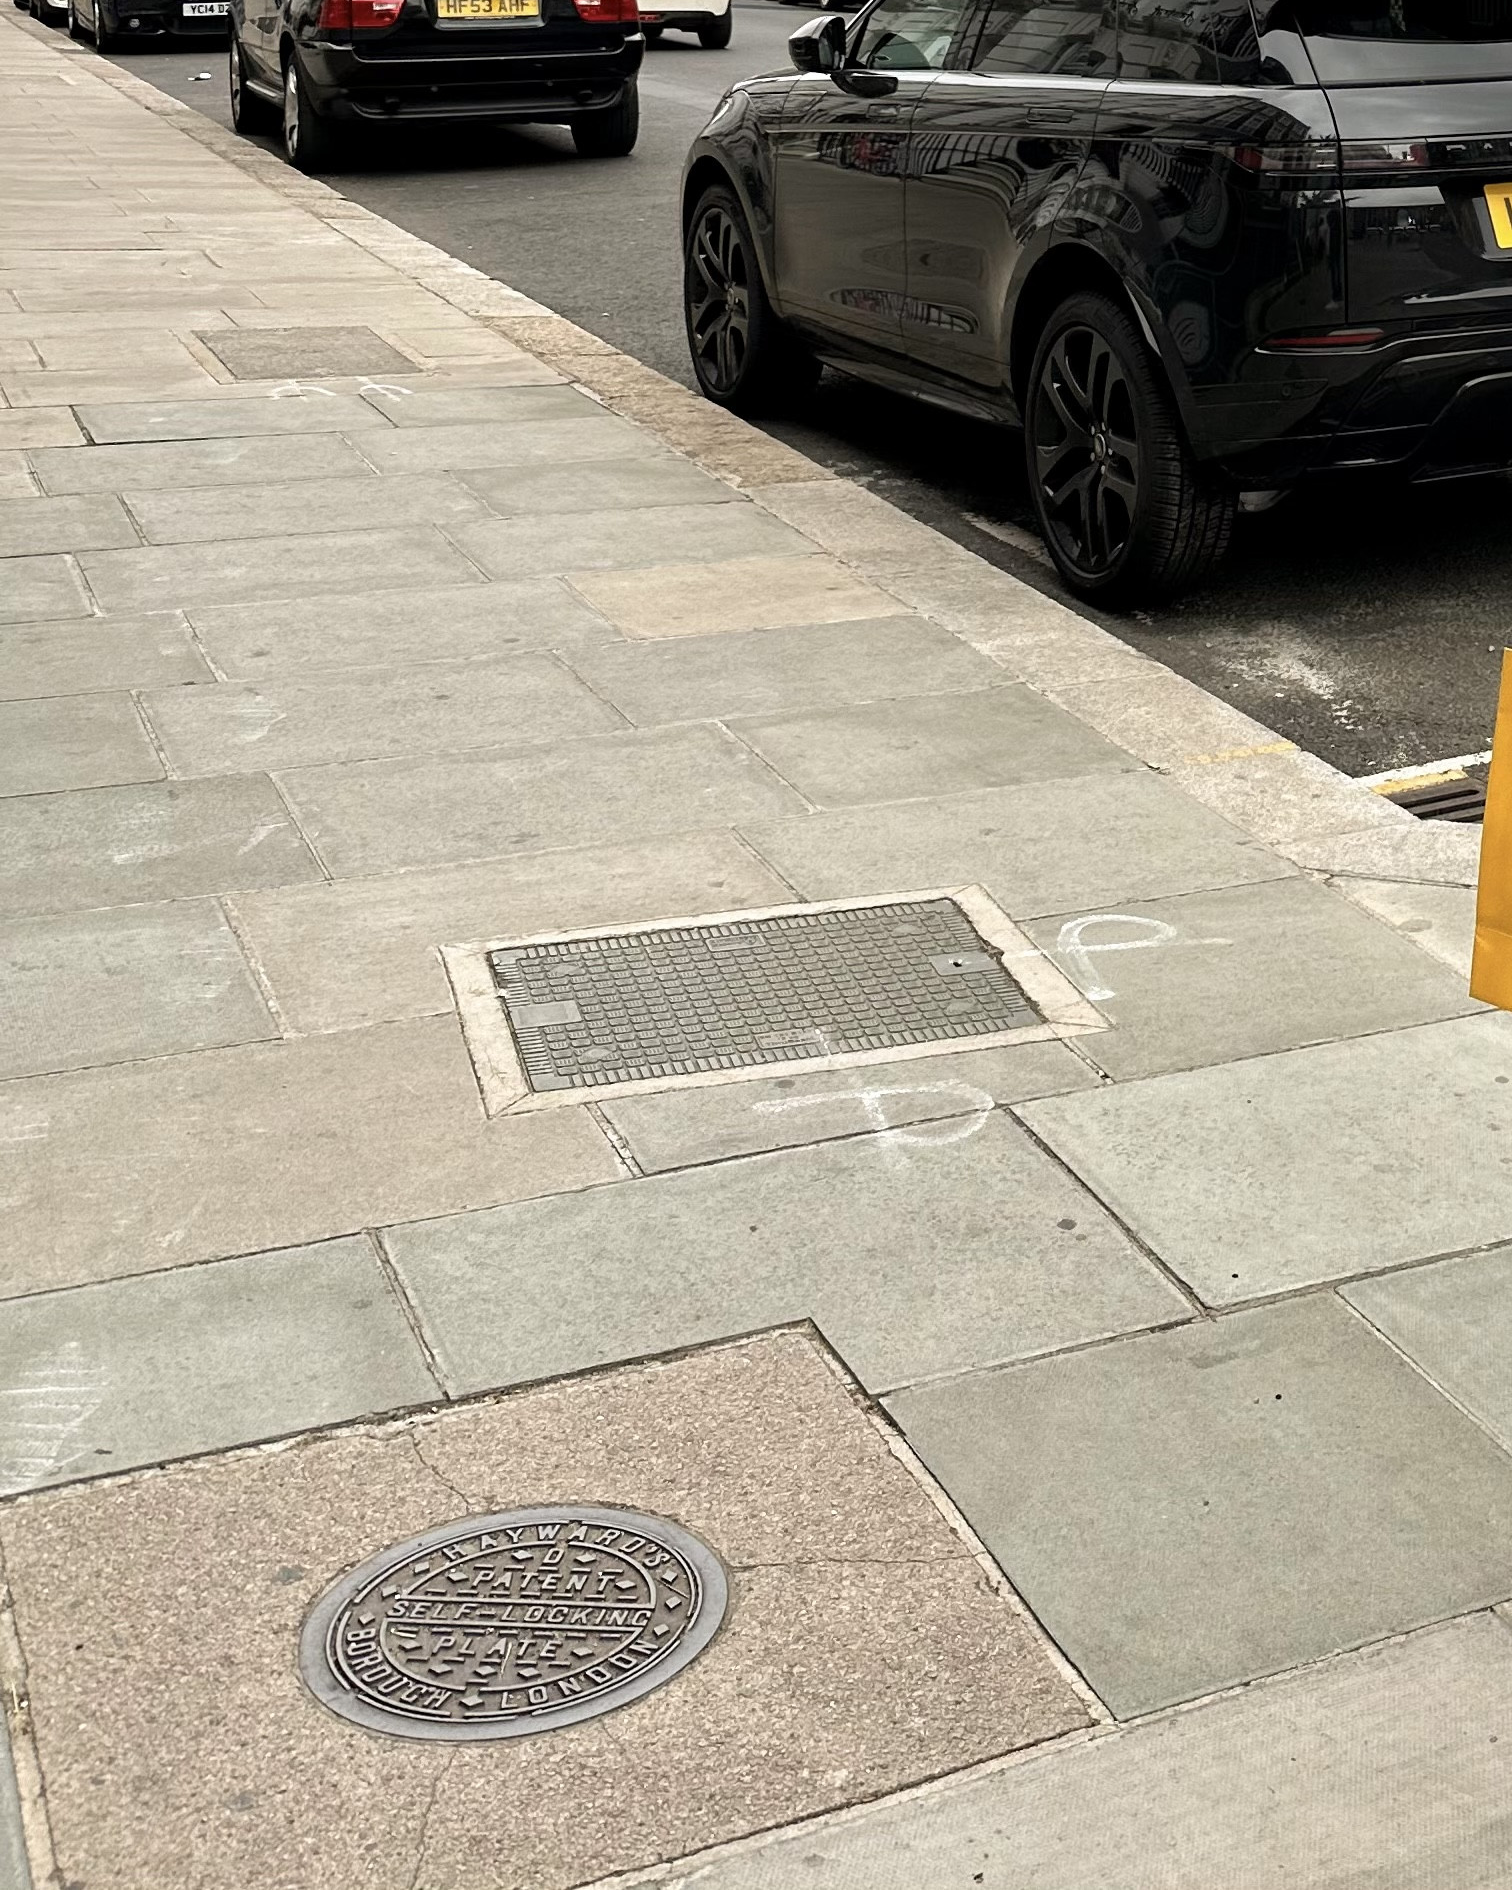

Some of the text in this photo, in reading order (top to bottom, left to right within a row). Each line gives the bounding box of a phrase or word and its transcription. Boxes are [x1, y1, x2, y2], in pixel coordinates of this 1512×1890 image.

[190, 4, 215, 14] YC14
[442, 1524, 671, 1568] HAYWARD'S
[471, 1569, 616, 1593] PATENT
[386, 1600, 654, 1627] SELF-LOCKING
[431, 1635, 564, 1659] PLATE
[346, 1627, 659, 1709] BOROUGH LONDON
